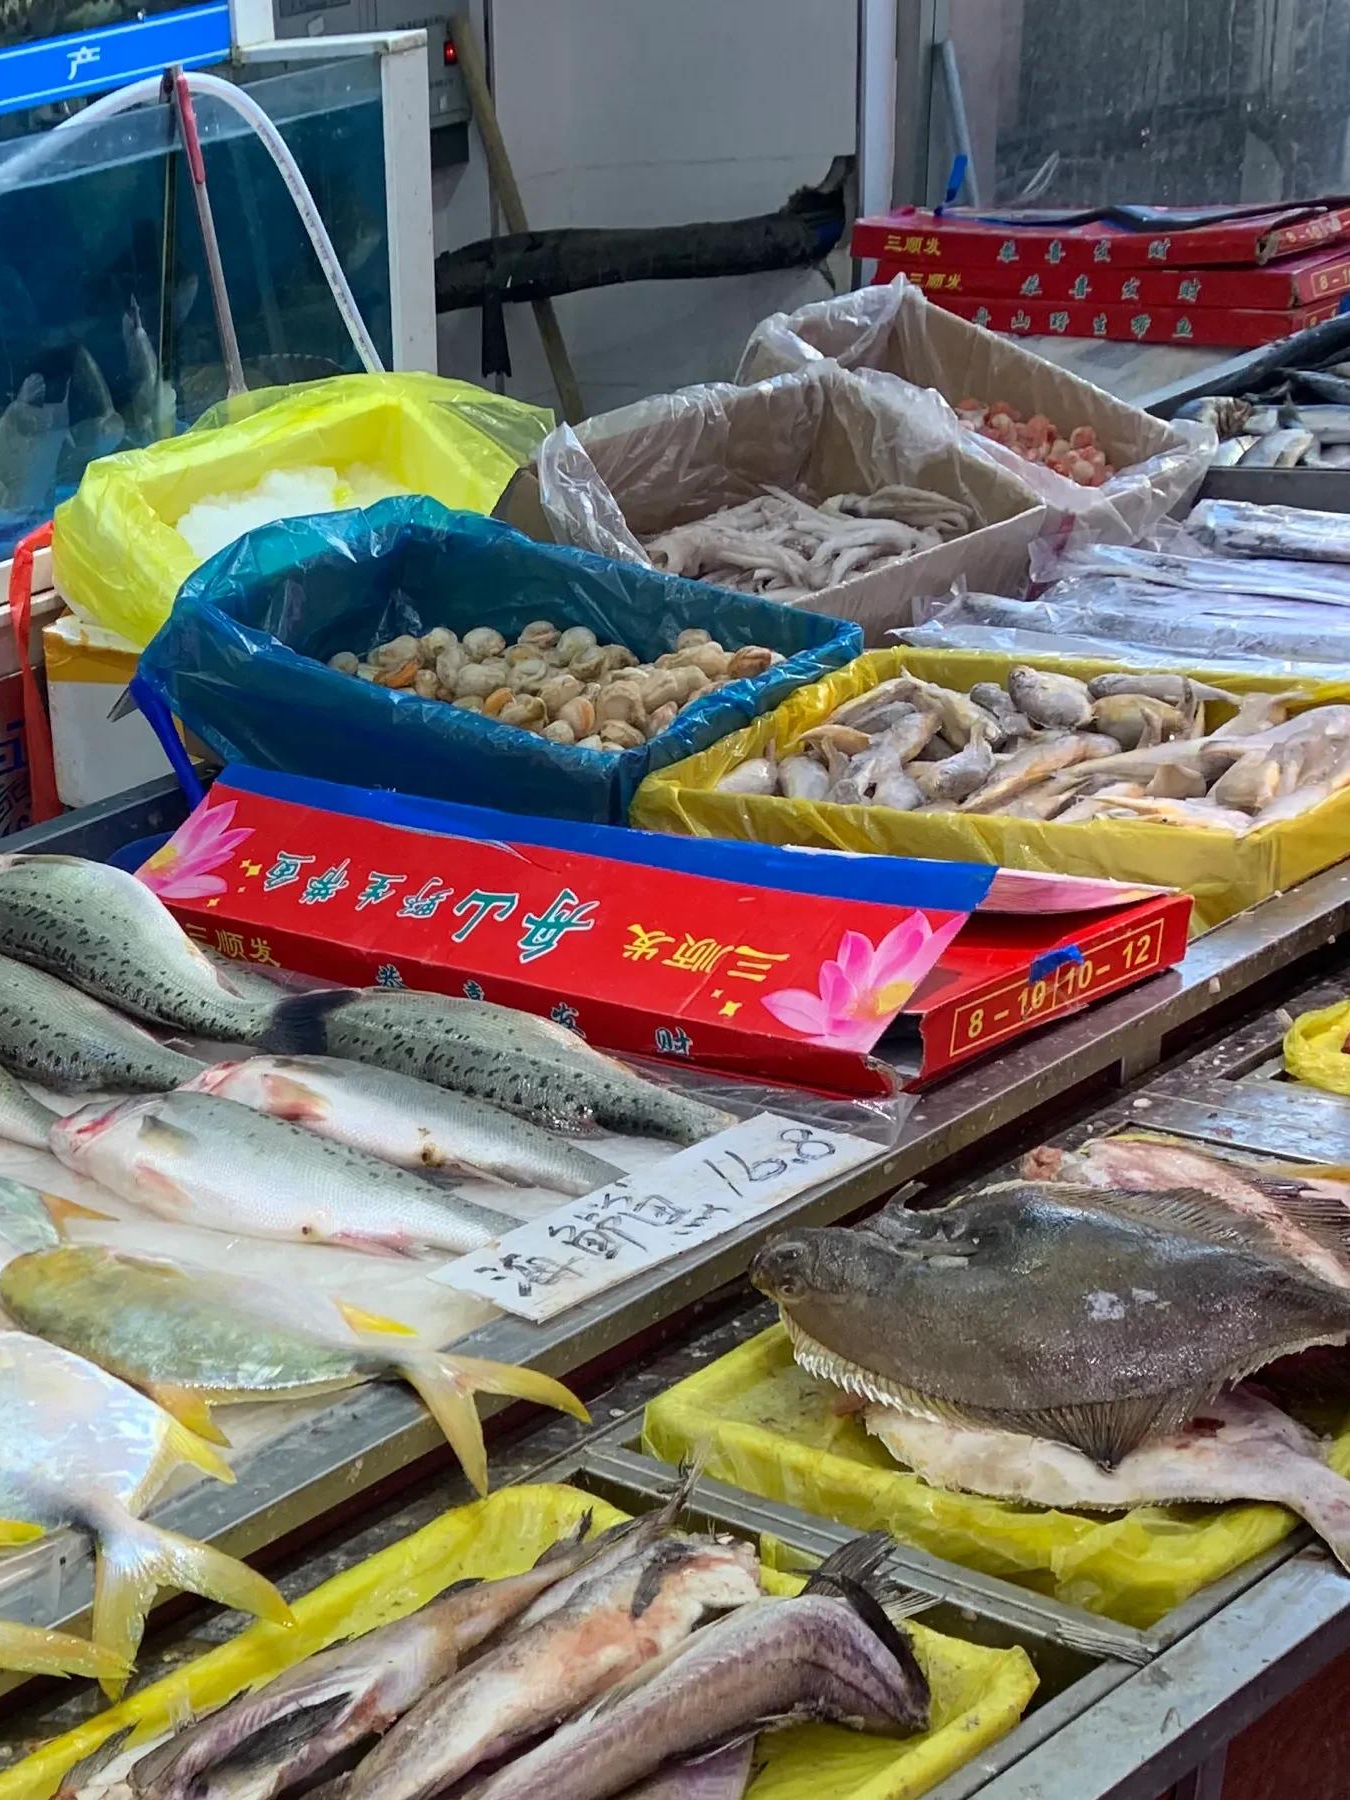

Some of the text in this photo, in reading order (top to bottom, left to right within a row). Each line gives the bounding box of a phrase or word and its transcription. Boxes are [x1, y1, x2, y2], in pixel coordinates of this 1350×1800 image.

[884, 234, 942, 257] 三顺发
[909, 271, 964, 292] 三顺发
[262, 850, 791, 983] 三顺发 舟山野生带鱼
[702, 1127, 837, 1199] 16.8
